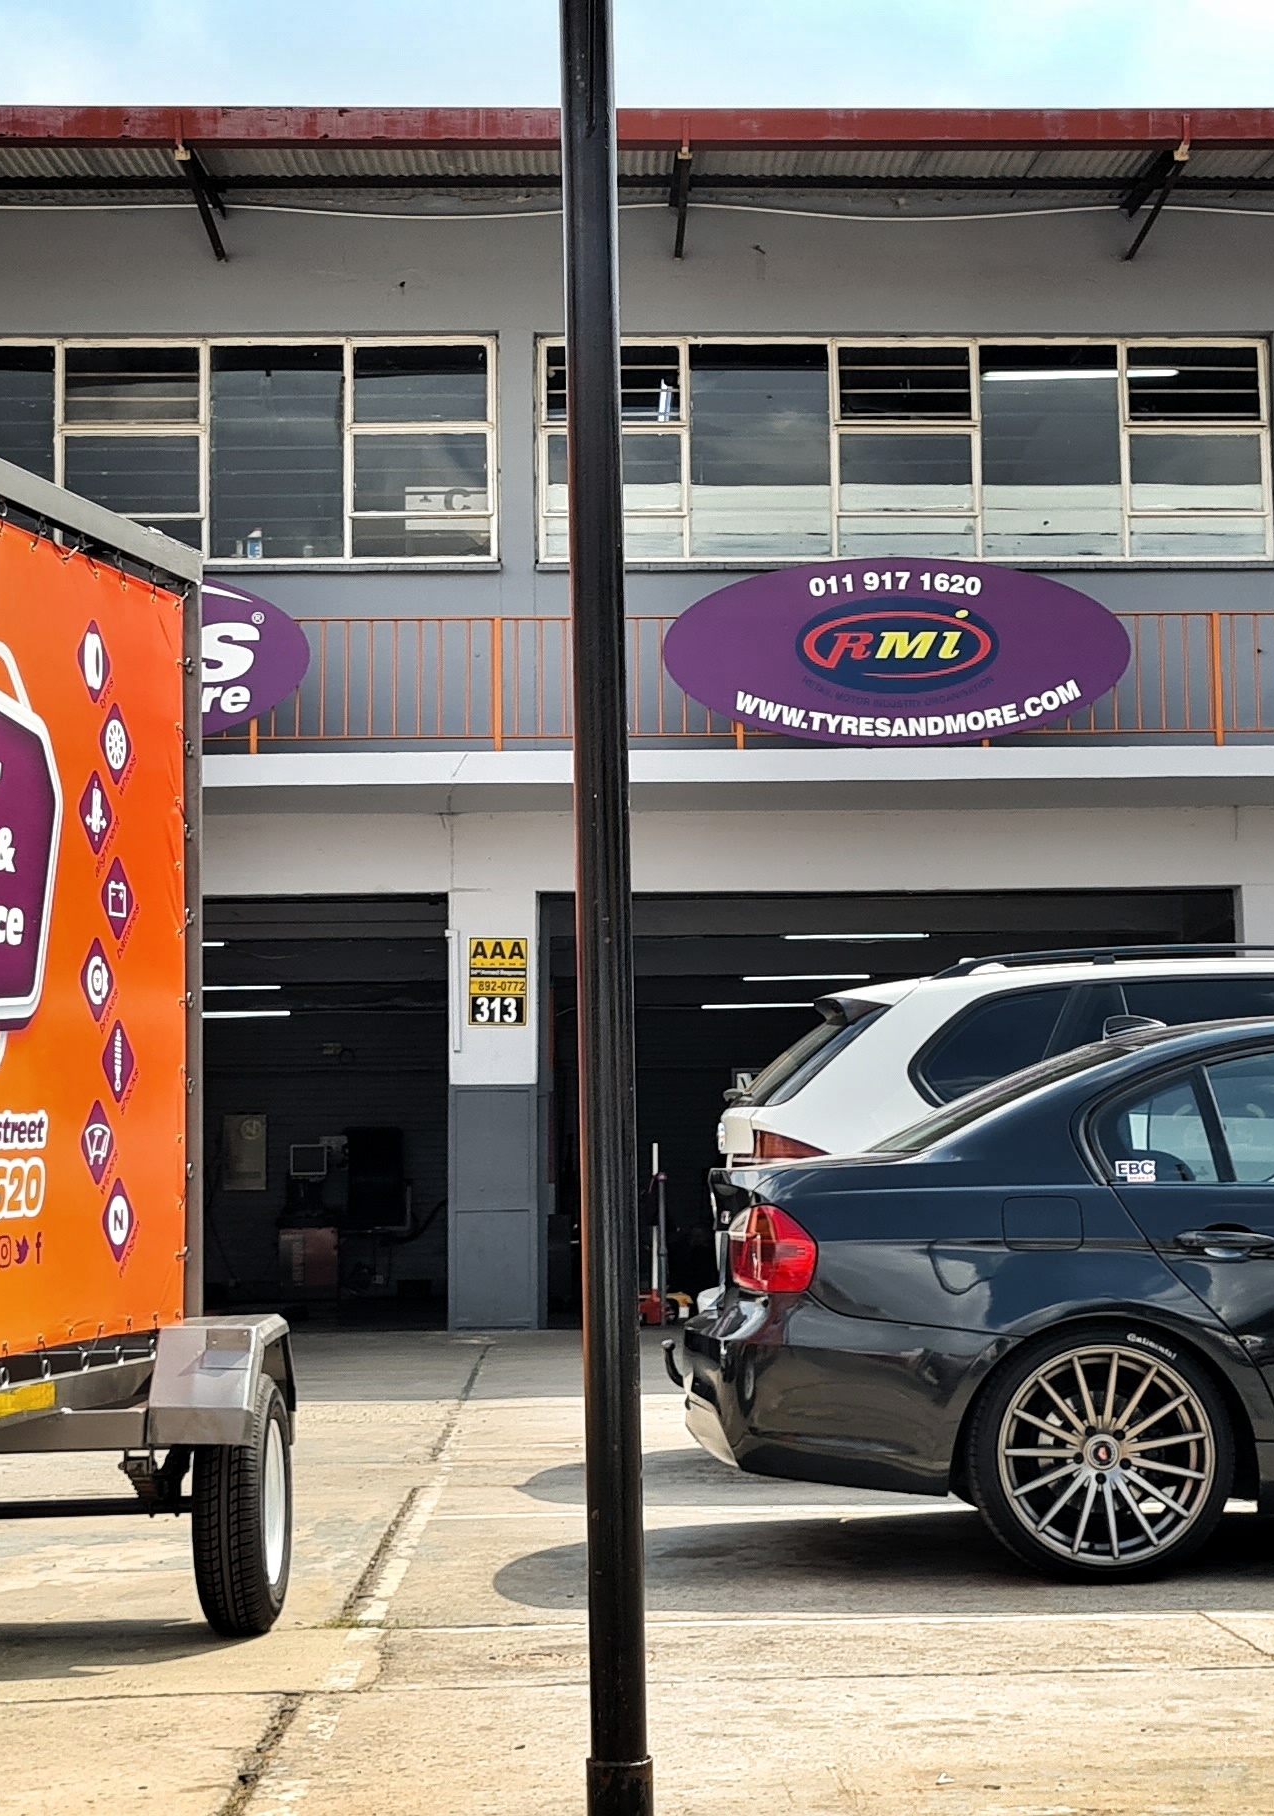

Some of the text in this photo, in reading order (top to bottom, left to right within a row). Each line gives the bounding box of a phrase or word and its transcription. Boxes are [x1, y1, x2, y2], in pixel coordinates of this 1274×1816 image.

[809, 571, 982, 597] 011 917 1620
[735, 679, 1083, 738] WWW.TYRESANDMORE.COM
[472, 941, 525, 960] AAA
[478, 981, 526, 992] 892-0772
[475, 997, 518, 1023] 313
[1117, 1162, 1154, 1175] EBC
